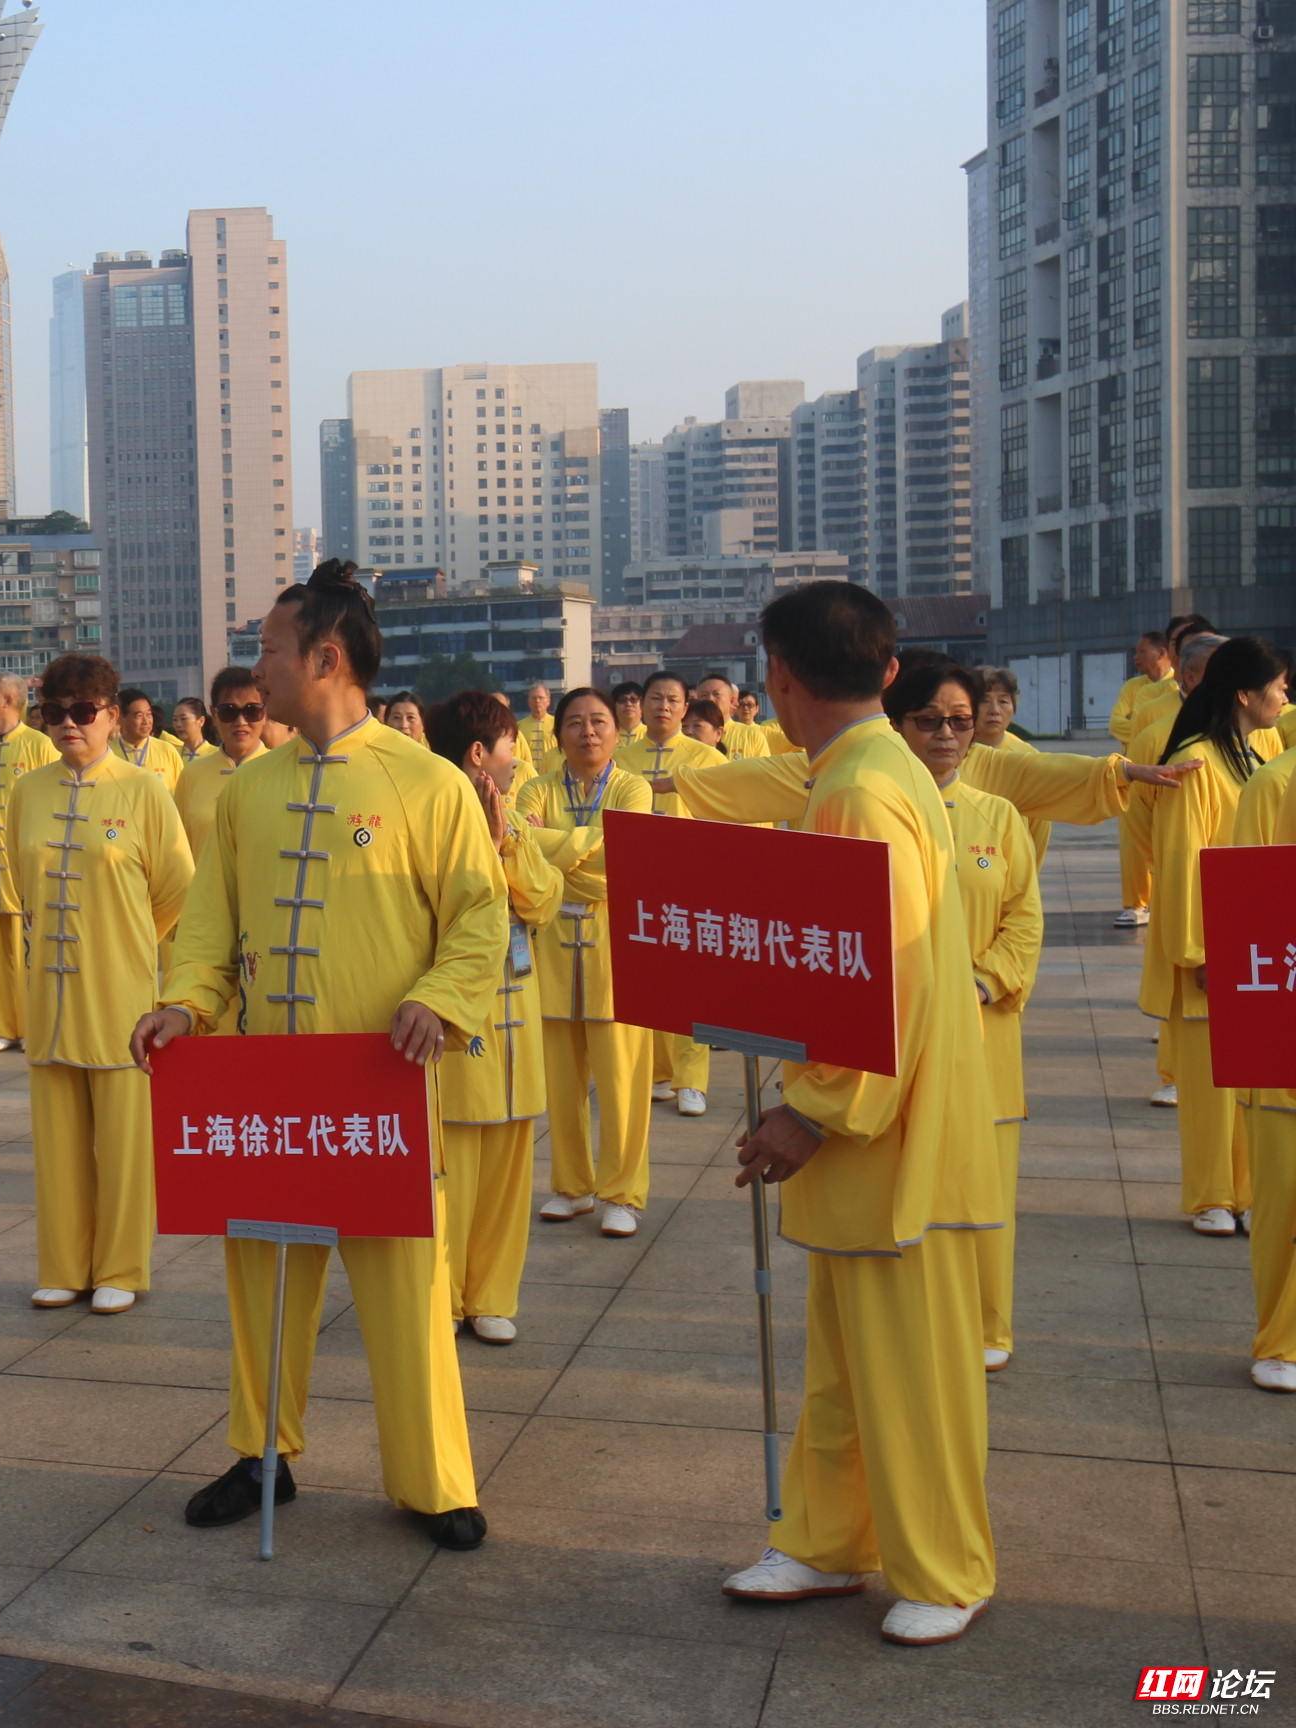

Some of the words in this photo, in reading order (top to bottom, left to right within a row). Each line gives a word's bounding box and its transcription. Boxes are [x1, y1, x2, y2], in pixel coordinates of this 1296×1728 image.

[628, 899, 872, 982] 上海南翔代表队
[173, 1113, 410, 1157] 上海徐汇代表队
